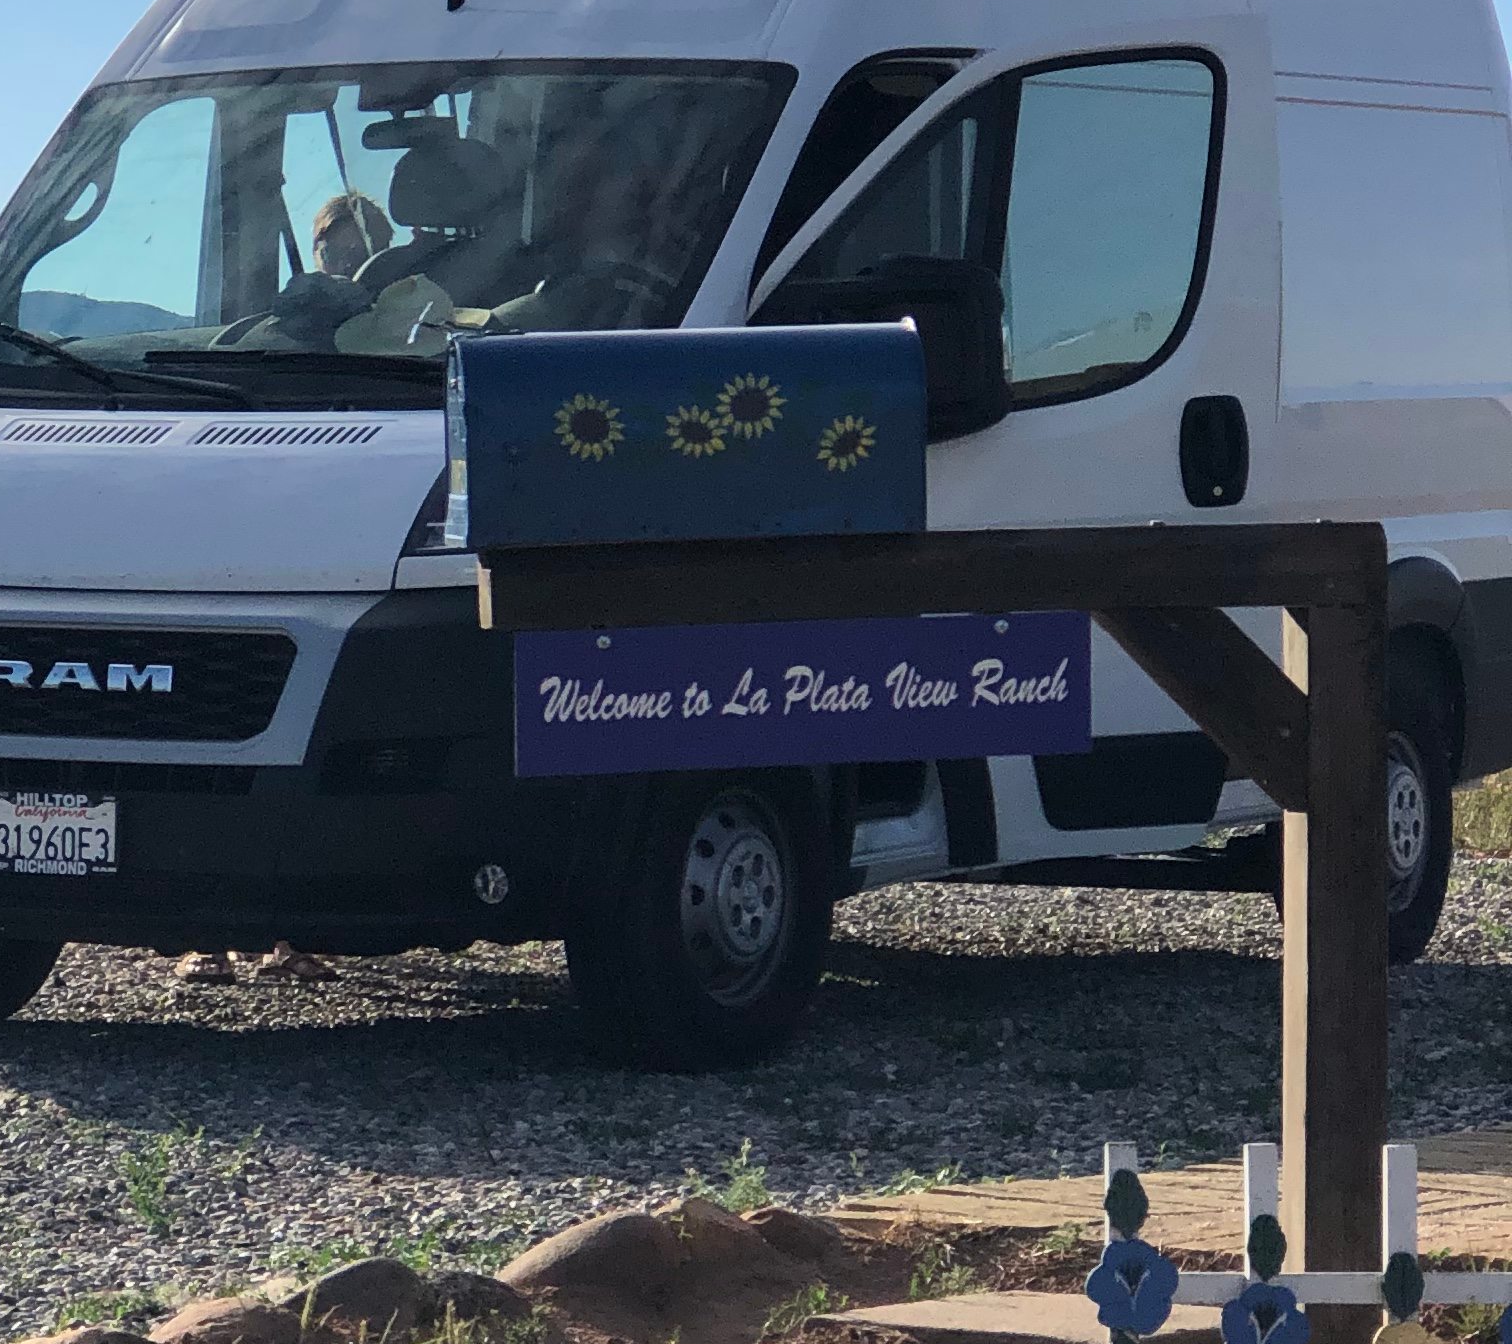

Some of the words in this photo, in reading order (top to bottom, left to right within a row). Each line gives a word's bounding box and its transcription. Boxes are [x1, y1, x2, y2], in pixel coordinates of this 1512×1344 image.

[540, 675, 674, 723] Welcome
[681, 682, 712, 719] to
[722, 667, 771, 716] La
[784, 664, 873, 715] Plata
[885, 661, 959, 710] View
[971, 657, 1070, 707] Ranch
[16, 792, 88, 807] HILLTOP
[15, 805, 95, 823] California
[14, 859, 87, 876] RICHMOND
